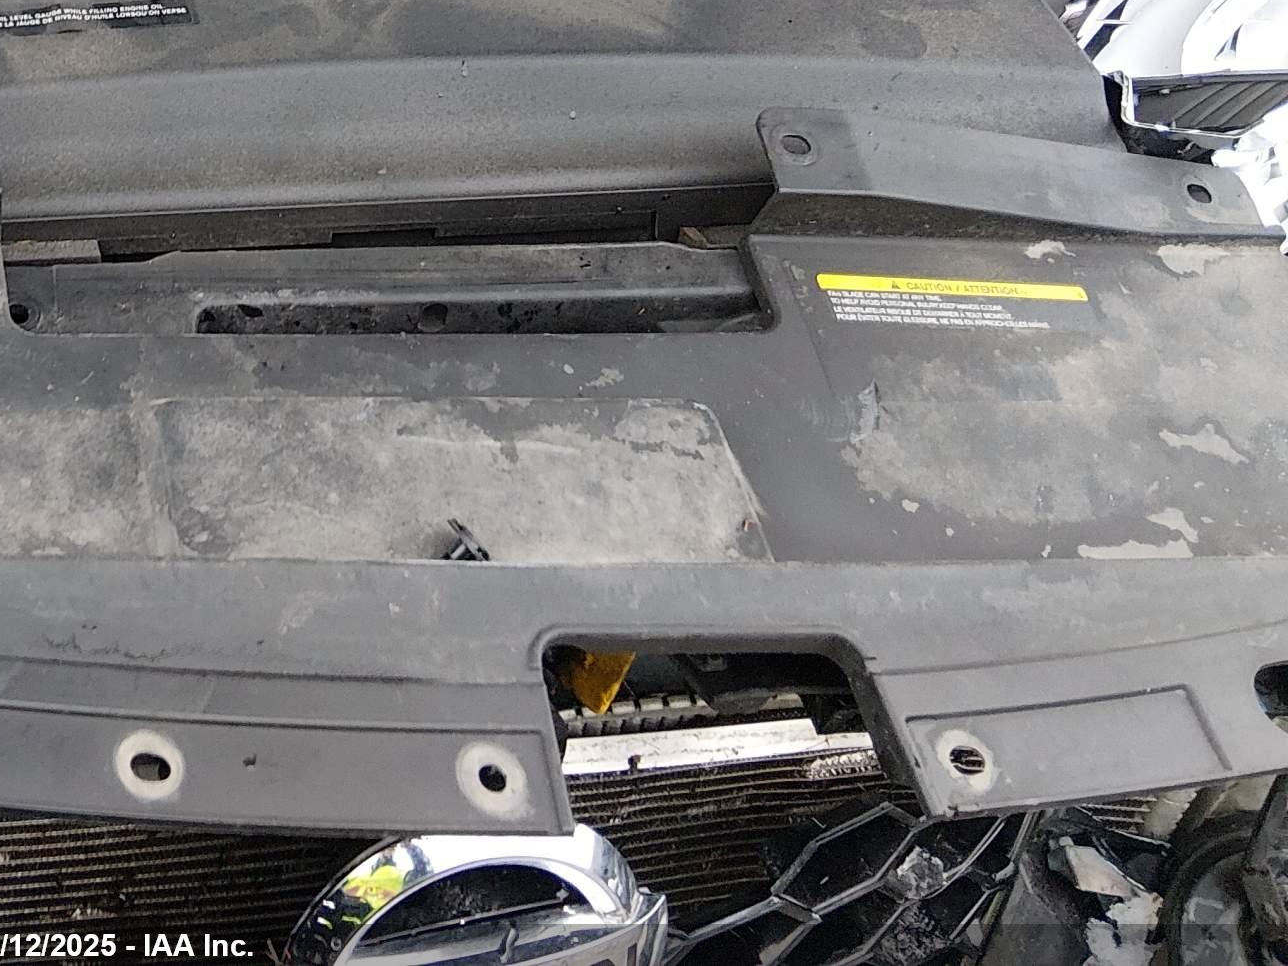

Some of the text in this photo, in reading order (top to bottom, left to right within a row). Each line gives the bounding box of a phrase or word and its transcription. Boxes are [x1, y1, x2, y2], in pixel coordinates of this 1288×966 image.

[10, 13, 33, 21] LEVEL
[35, 8, 62, 19] GAUGE
[89, 6, 118, 14] FILLING
[120, 4, 149, 12] ENGINE
[16, 18, 41, 27] JAUGE
[55, 14, 82, 22] NIVEAU
[84, 13, 114, 21] D'HUILE
[162, 7, 188, 15] VERSE
[906, 281, 953, 292] CAUTION
[963, 284, 1018, 295] ATTENTION
